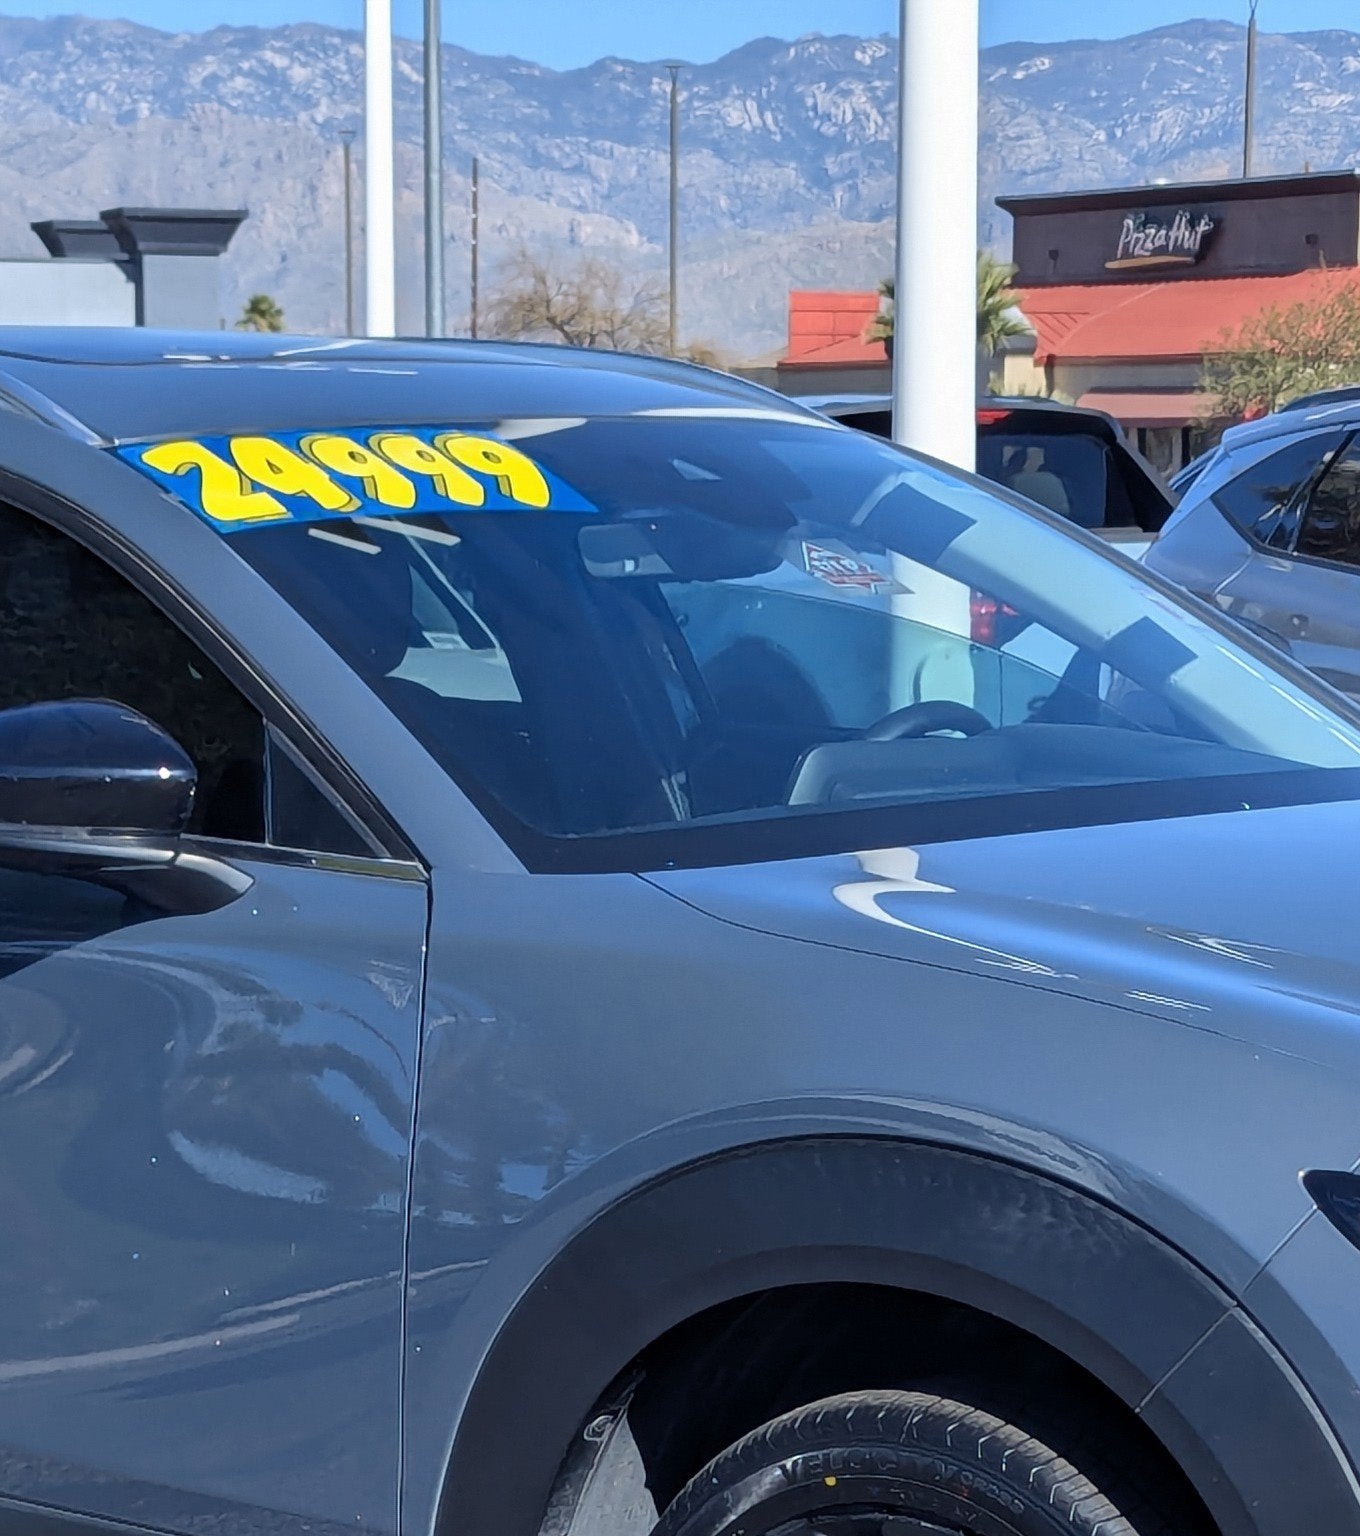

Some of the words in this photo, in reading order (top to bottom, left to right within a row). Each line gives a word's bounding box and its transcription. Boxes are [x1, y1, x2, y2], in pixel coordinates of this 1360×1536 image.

[1116, 212, 1167, 258] Pizza
[1168, 209, 1214, 252] Hut
[140, 432, 551, 522] 24999
